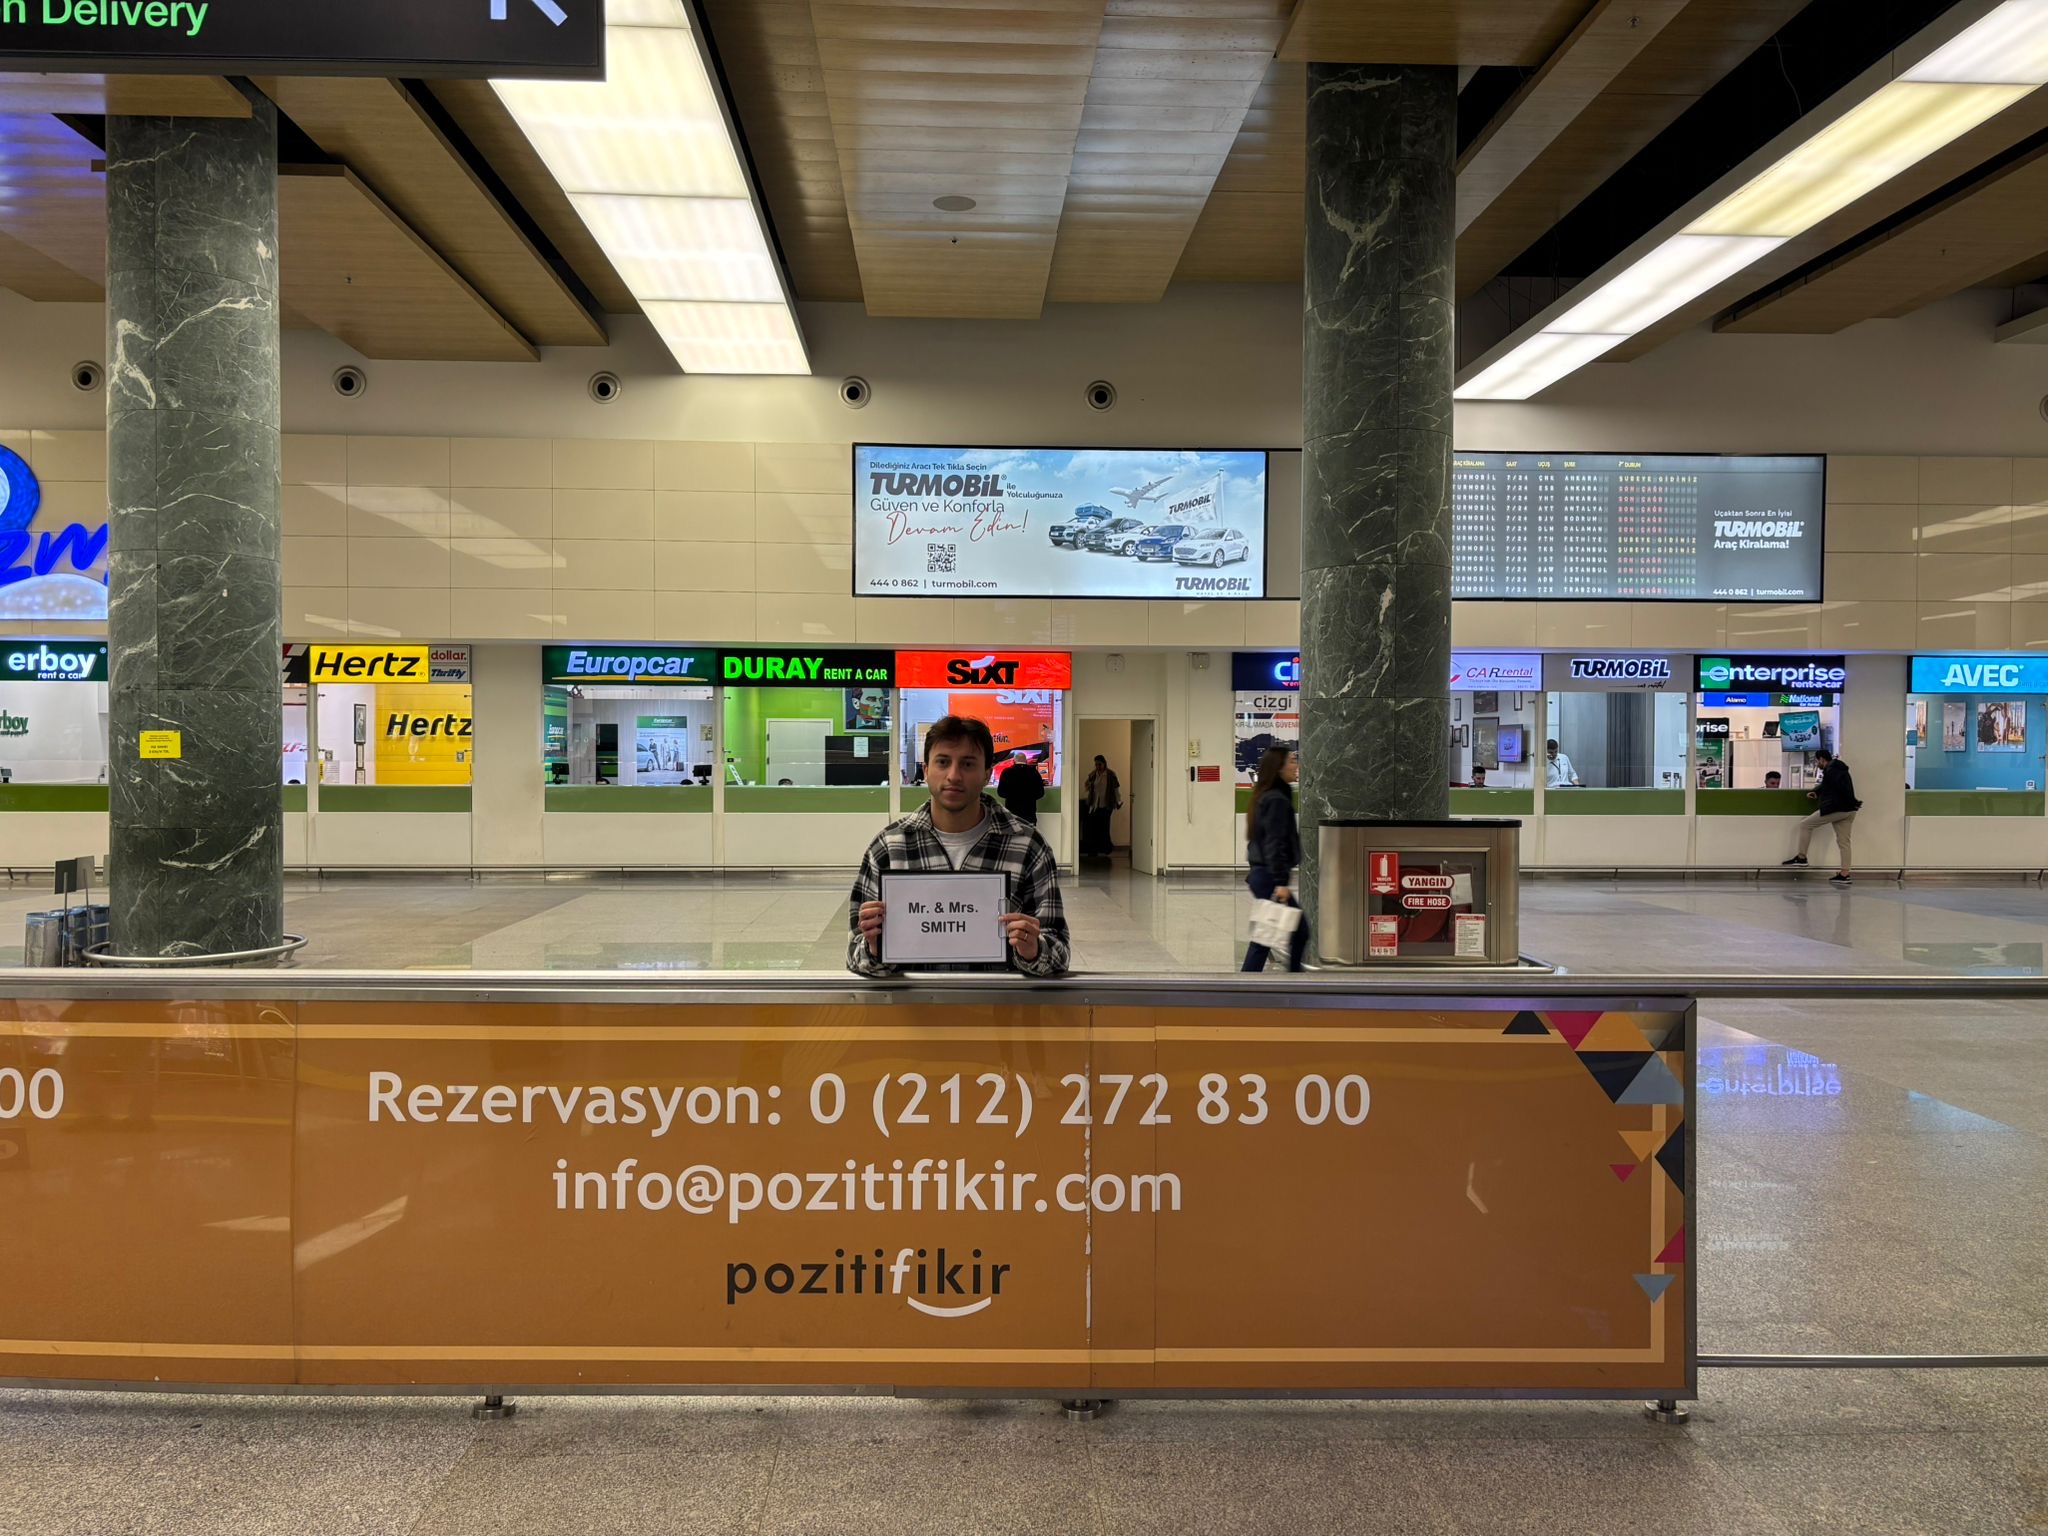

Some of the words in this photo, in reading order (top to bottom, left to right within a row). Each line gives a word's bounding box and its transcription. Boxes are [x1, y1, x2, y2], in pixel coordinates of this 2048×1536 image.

[43, 0, 208, 36] Delivery
[870, 462, 910, 470] Dilediğiniz
[966, 464, 987, 472] Seçin
[1007, 491, 1063, 500] Yolculuğunuza
[870, 498, 918, 512] Güven
[922, 502, 940, 512] ve
[944, 500, 1005, 513] Konforla
[886, 511, 964, 546] Devam
[1714, 540, 1738, 550] Araç
[932, 580, 997, 588] turmobil.com
[8, 644, 96, 678] erboy
[315, 652, 420, 676] Hertz
[566, 651, 694, 680] Europcar
[724, 657, 823, 679] DURAY
[824, 669, 852, 680] RENT
[855, 669, 863, 680] A
[866, 669, 887, 680] CAR
[38, 671, 57, 679] rent
[431, 668, 466, 679] Thrifty
[1466, 667, 1500, 678] CAR
[1502, 668, 1533, 676] rental
[1703, 663, 1845, 685] enterprise
[1940, 664, 2019, 686] AVEC
[1254, 695, 1292, 711] cizgi
[1789, 695, 1822, 703] National
[386, 714, 472, 736] Hertz
[1409, 878, 1446, 886] YANGIN
[909, 903, 929, 913] Mr.
[934, 902, 944, 913] &
[950, 902, 978, 913] Mrs.
[921, 921, 966, 933] SMITH
[370, 1071, 782, 1137] Rezervasyon:
[810, 1072, 846, 1125] 0
[872, 1072, 1034, 1138] (212)
[1061, 1072, 1172, 1126] 272
[1196, 1073, 1269, 1126] 83
[1296, 1074, 1371, 1126] 00
[552, 1158, 1182, 1224] info@pozitifikir.com
[726, 1248, 1010, 1304] pozitifikir
